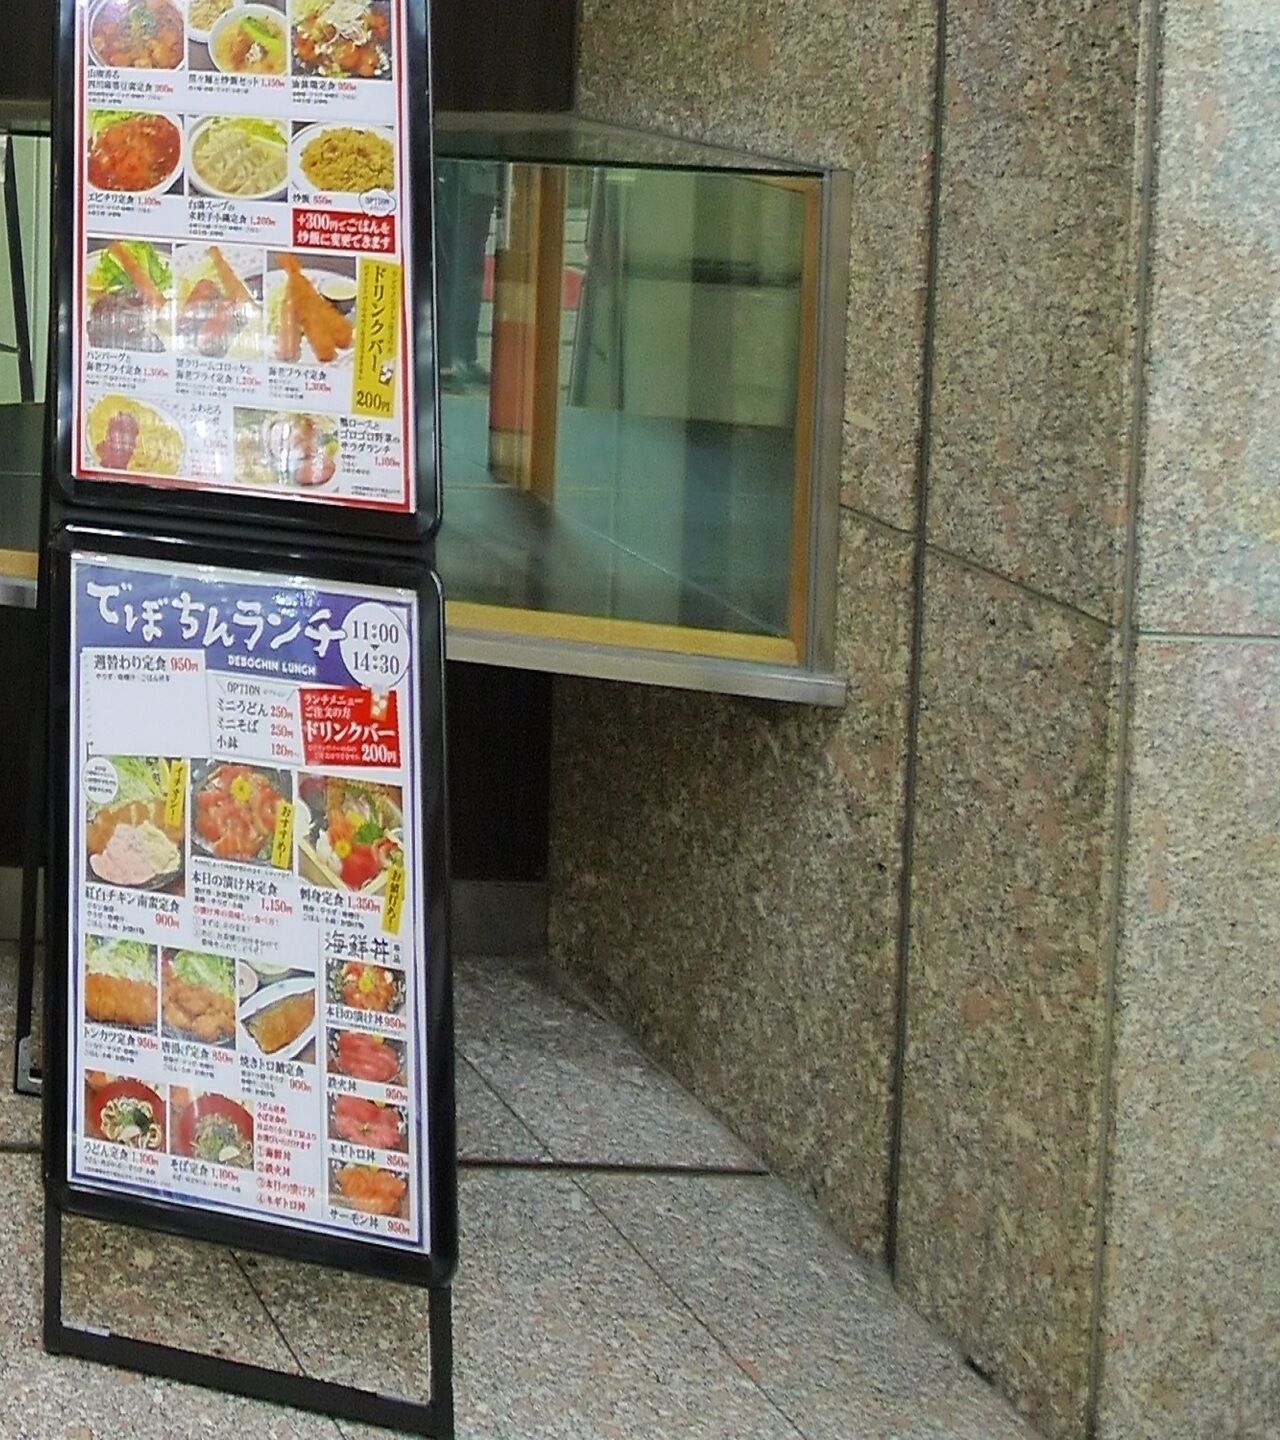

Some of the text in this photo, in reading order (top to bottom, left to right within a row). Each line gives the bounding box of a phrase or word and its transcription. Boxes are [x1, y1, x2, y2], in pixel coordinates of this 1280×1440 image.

[368, 264, 387, 373] ドリンクバー
[356, 389, 390, 413] 200円
[86, 581, 348, 659] でぼちんランチ
[352, 620, 400, 644] 11:00
[93, 654, 199, 673] 週替わり定食 950円
[227, 654, 317, 677] DEBOCHIN LUNCH
[352, 651, 401, 676] 14:30
[226, 681, 261, 696] OPTION
[303, 693, 365, 706] ランチメニュー
[216, 697, 294, 721] ミニうどん 250円
[304, 706, 352, 719] ご注文の方
[216, 717, 294, 739] ミニそば 250円
[304, 721, 396, 743] ドリンクバー
[216, 735, 239, 750] 小鉢
[360, 743, 397, 764] 200円
[191, 870, 279, 897] 本日の漬け丼定食
[260, 897, 293, 914] 1,150円
[324, 929, 390, 964] 海鮮丼
[83, 1026, 135, 1047] トンカツ定食
[83, 1142, 129, 1160] うどん定食
[170, 1158, 209, 1176] そば定食
